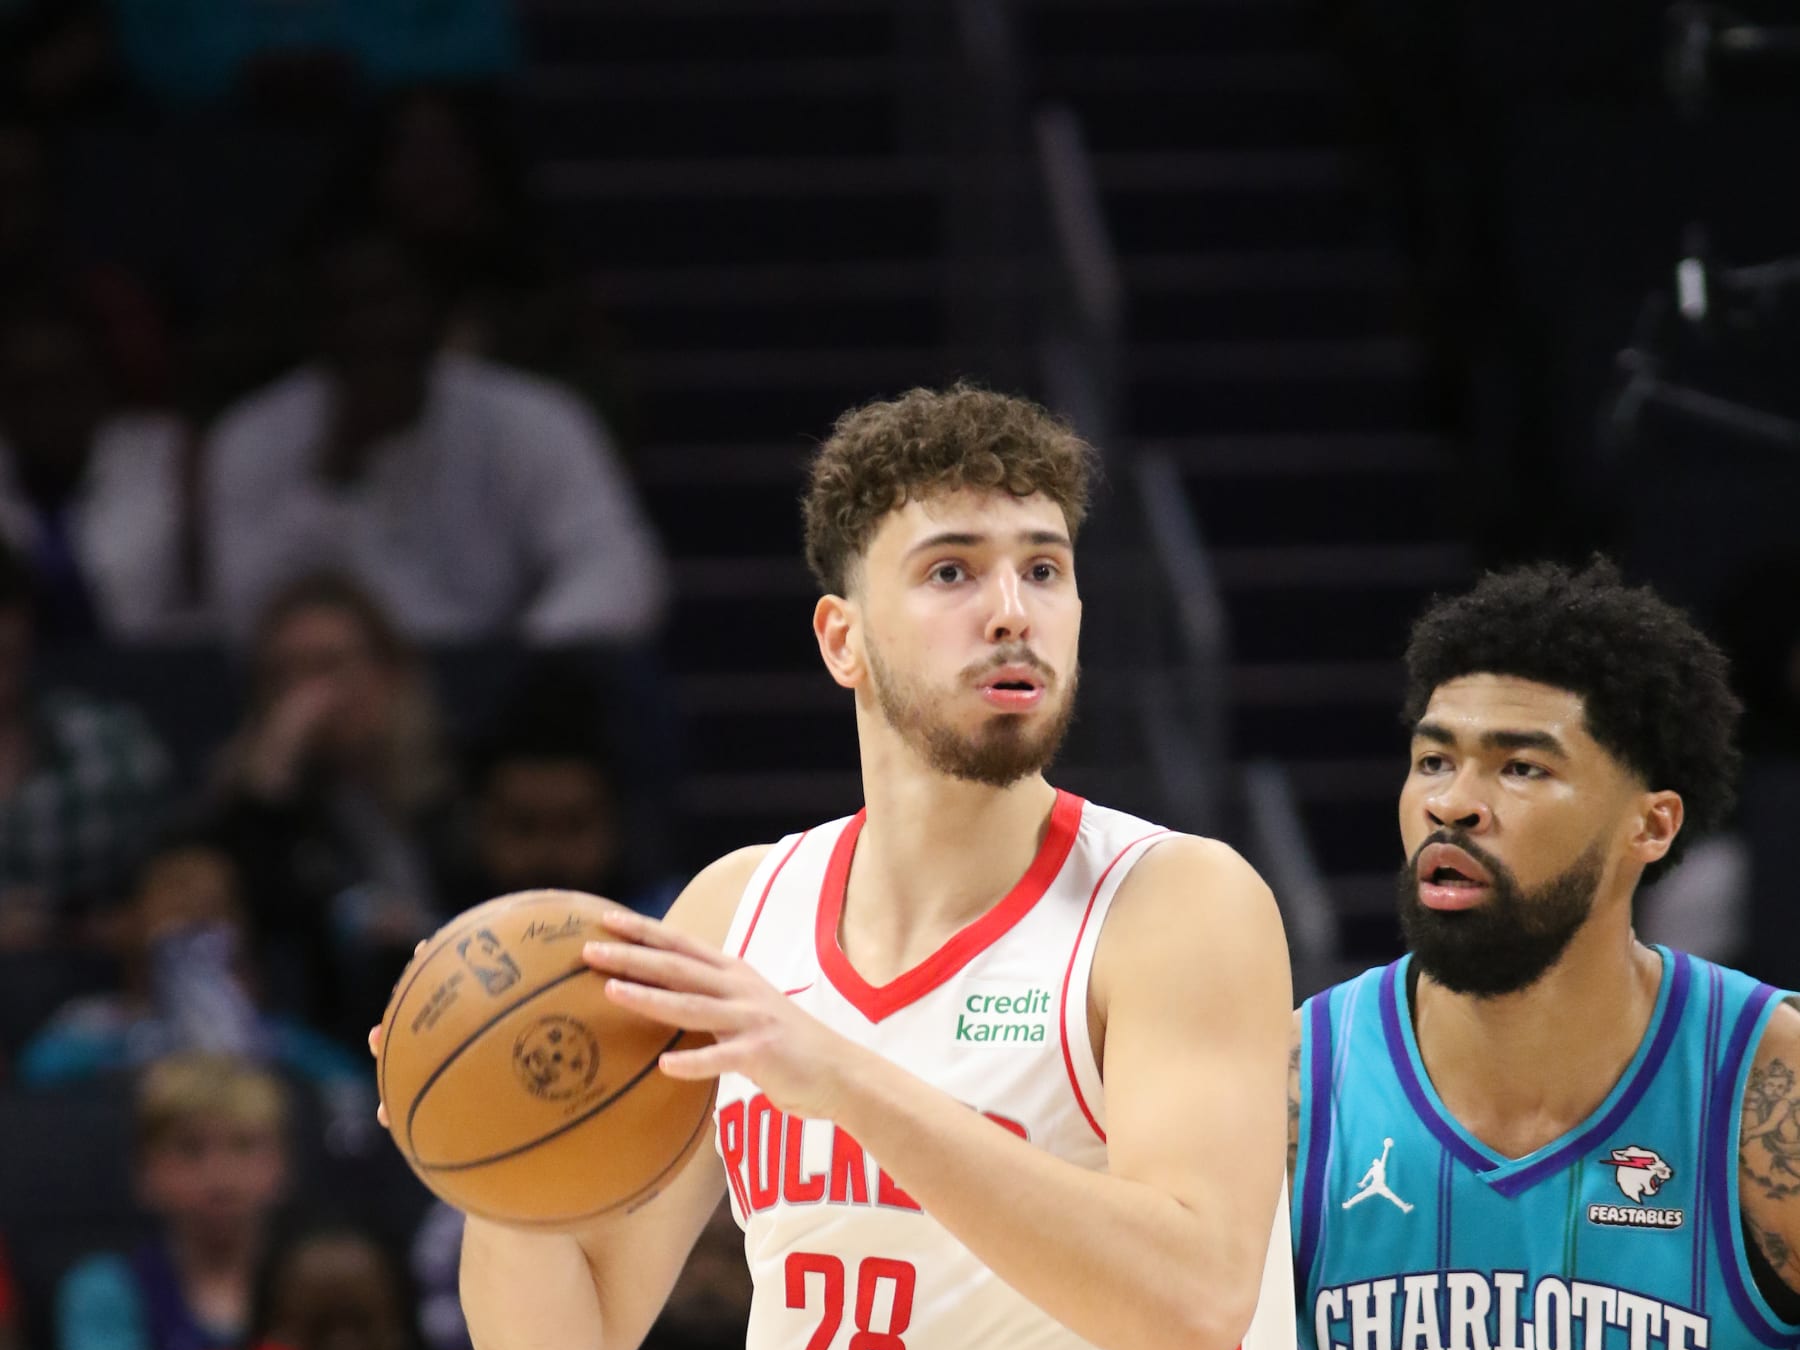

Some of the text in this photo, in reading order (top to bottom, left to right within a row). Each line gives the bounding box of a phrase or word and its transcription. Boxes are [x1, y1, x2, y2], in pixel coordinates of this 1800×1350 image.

[966, 989, 1050, 1014] credit
[956, 1014, 1045, 1041] karma
[1588, 1205, 1684, 1228] FEASTABLES
